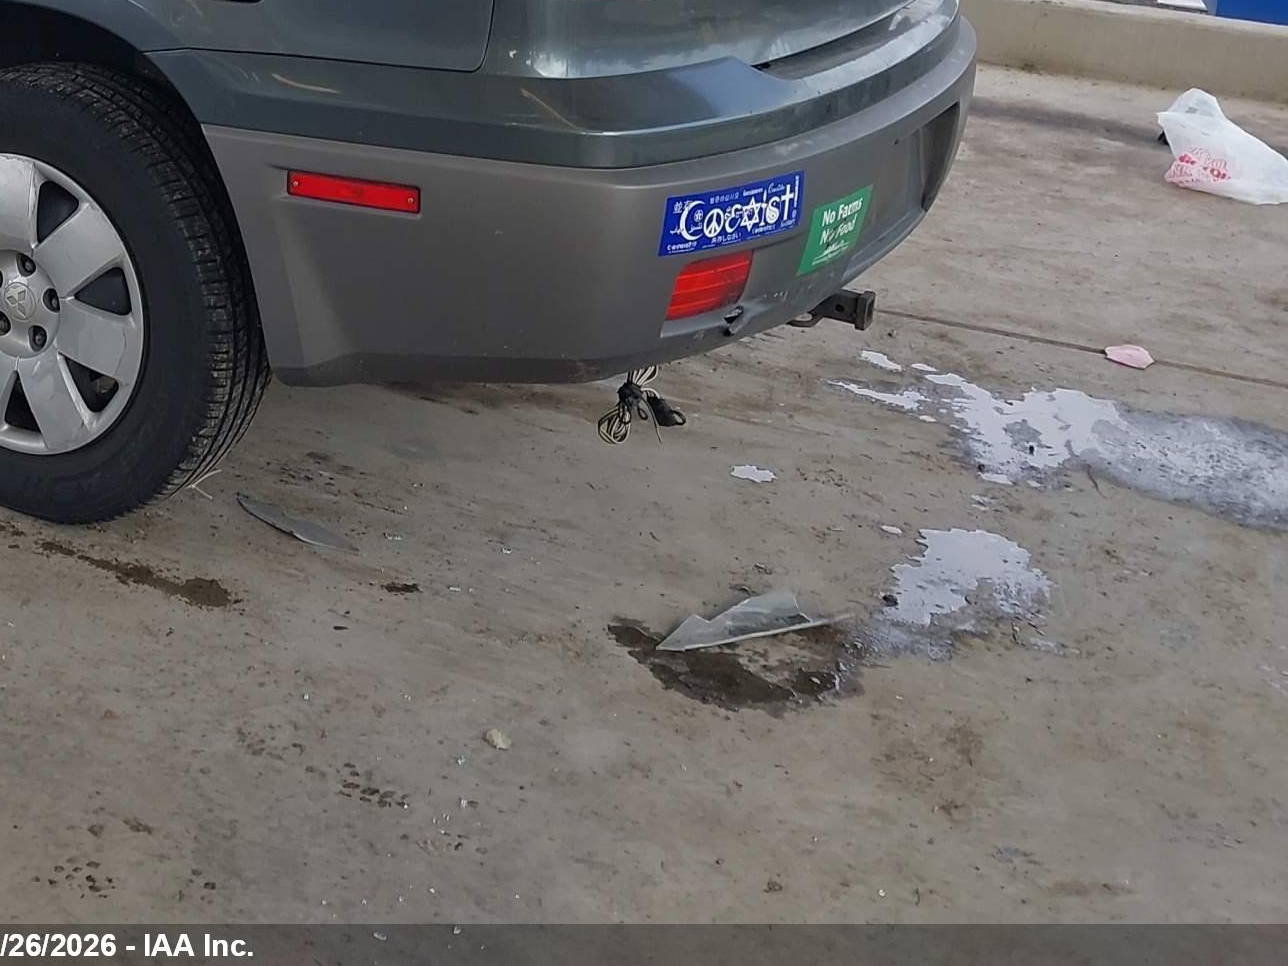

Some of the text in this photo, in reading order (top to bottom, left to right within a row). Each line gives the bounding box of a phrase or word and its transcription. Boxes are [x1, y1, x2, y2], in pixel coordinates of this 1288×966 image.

[821, 209, 836, 227] No
[837, 197, 863, 221] Farms
[834, 213, 858, 239] Food
